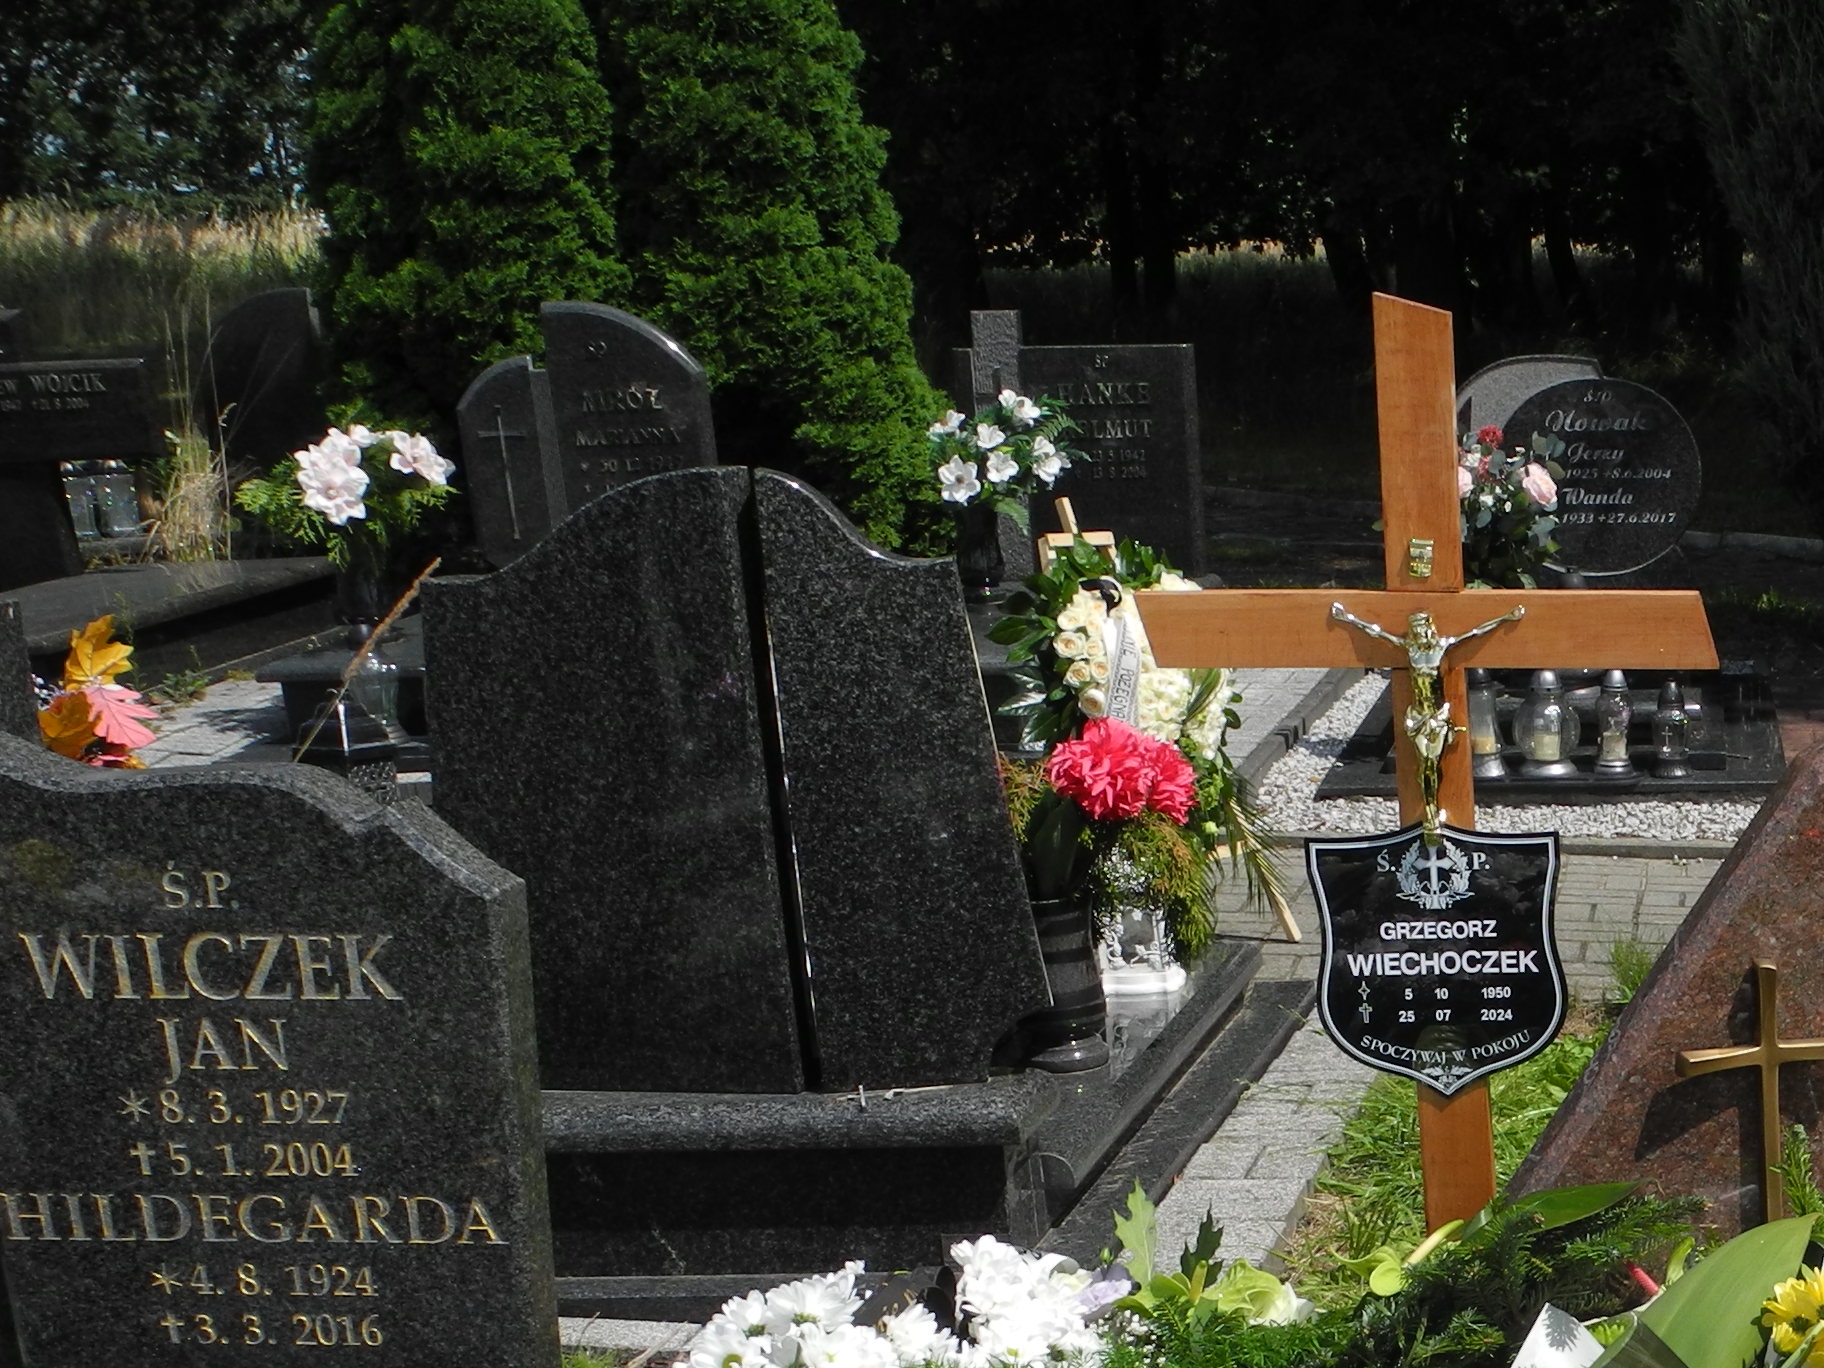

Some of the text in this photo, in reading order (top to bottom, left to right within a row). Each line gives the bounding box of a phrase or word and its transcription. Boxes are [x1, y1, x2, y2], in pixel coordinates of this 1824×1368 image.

[1070, 419, 1152, 439] ELMUT
[1561, 487, 1634, 505] Wanda
[161, 860, 240, 909] Ś.P.
[1379, 919, 1498, 941] GRZEGORZ
[18, 931, 404, 1001] WILCZEK
[1346, 949, 1540, 977] WIECHOCZEK
[1404, 986, 1512, 1001] 5 10 1950
[1398, 1008, 1513, 1023] 25 07 2024
[156, 1018, 290, 1085] JAN
[1360, 1029, 1531, 1065] SPOCZYWAJ W POKOJU
[256, 1089, 348, 1125] 1927
[263, 1142, 359, 1178] 2004
[0, 1192, 510, 1246] HILDEGARDA
[284, 1264, 378, 1298] 1924
[291, 1314, 384, 1347] 2016
